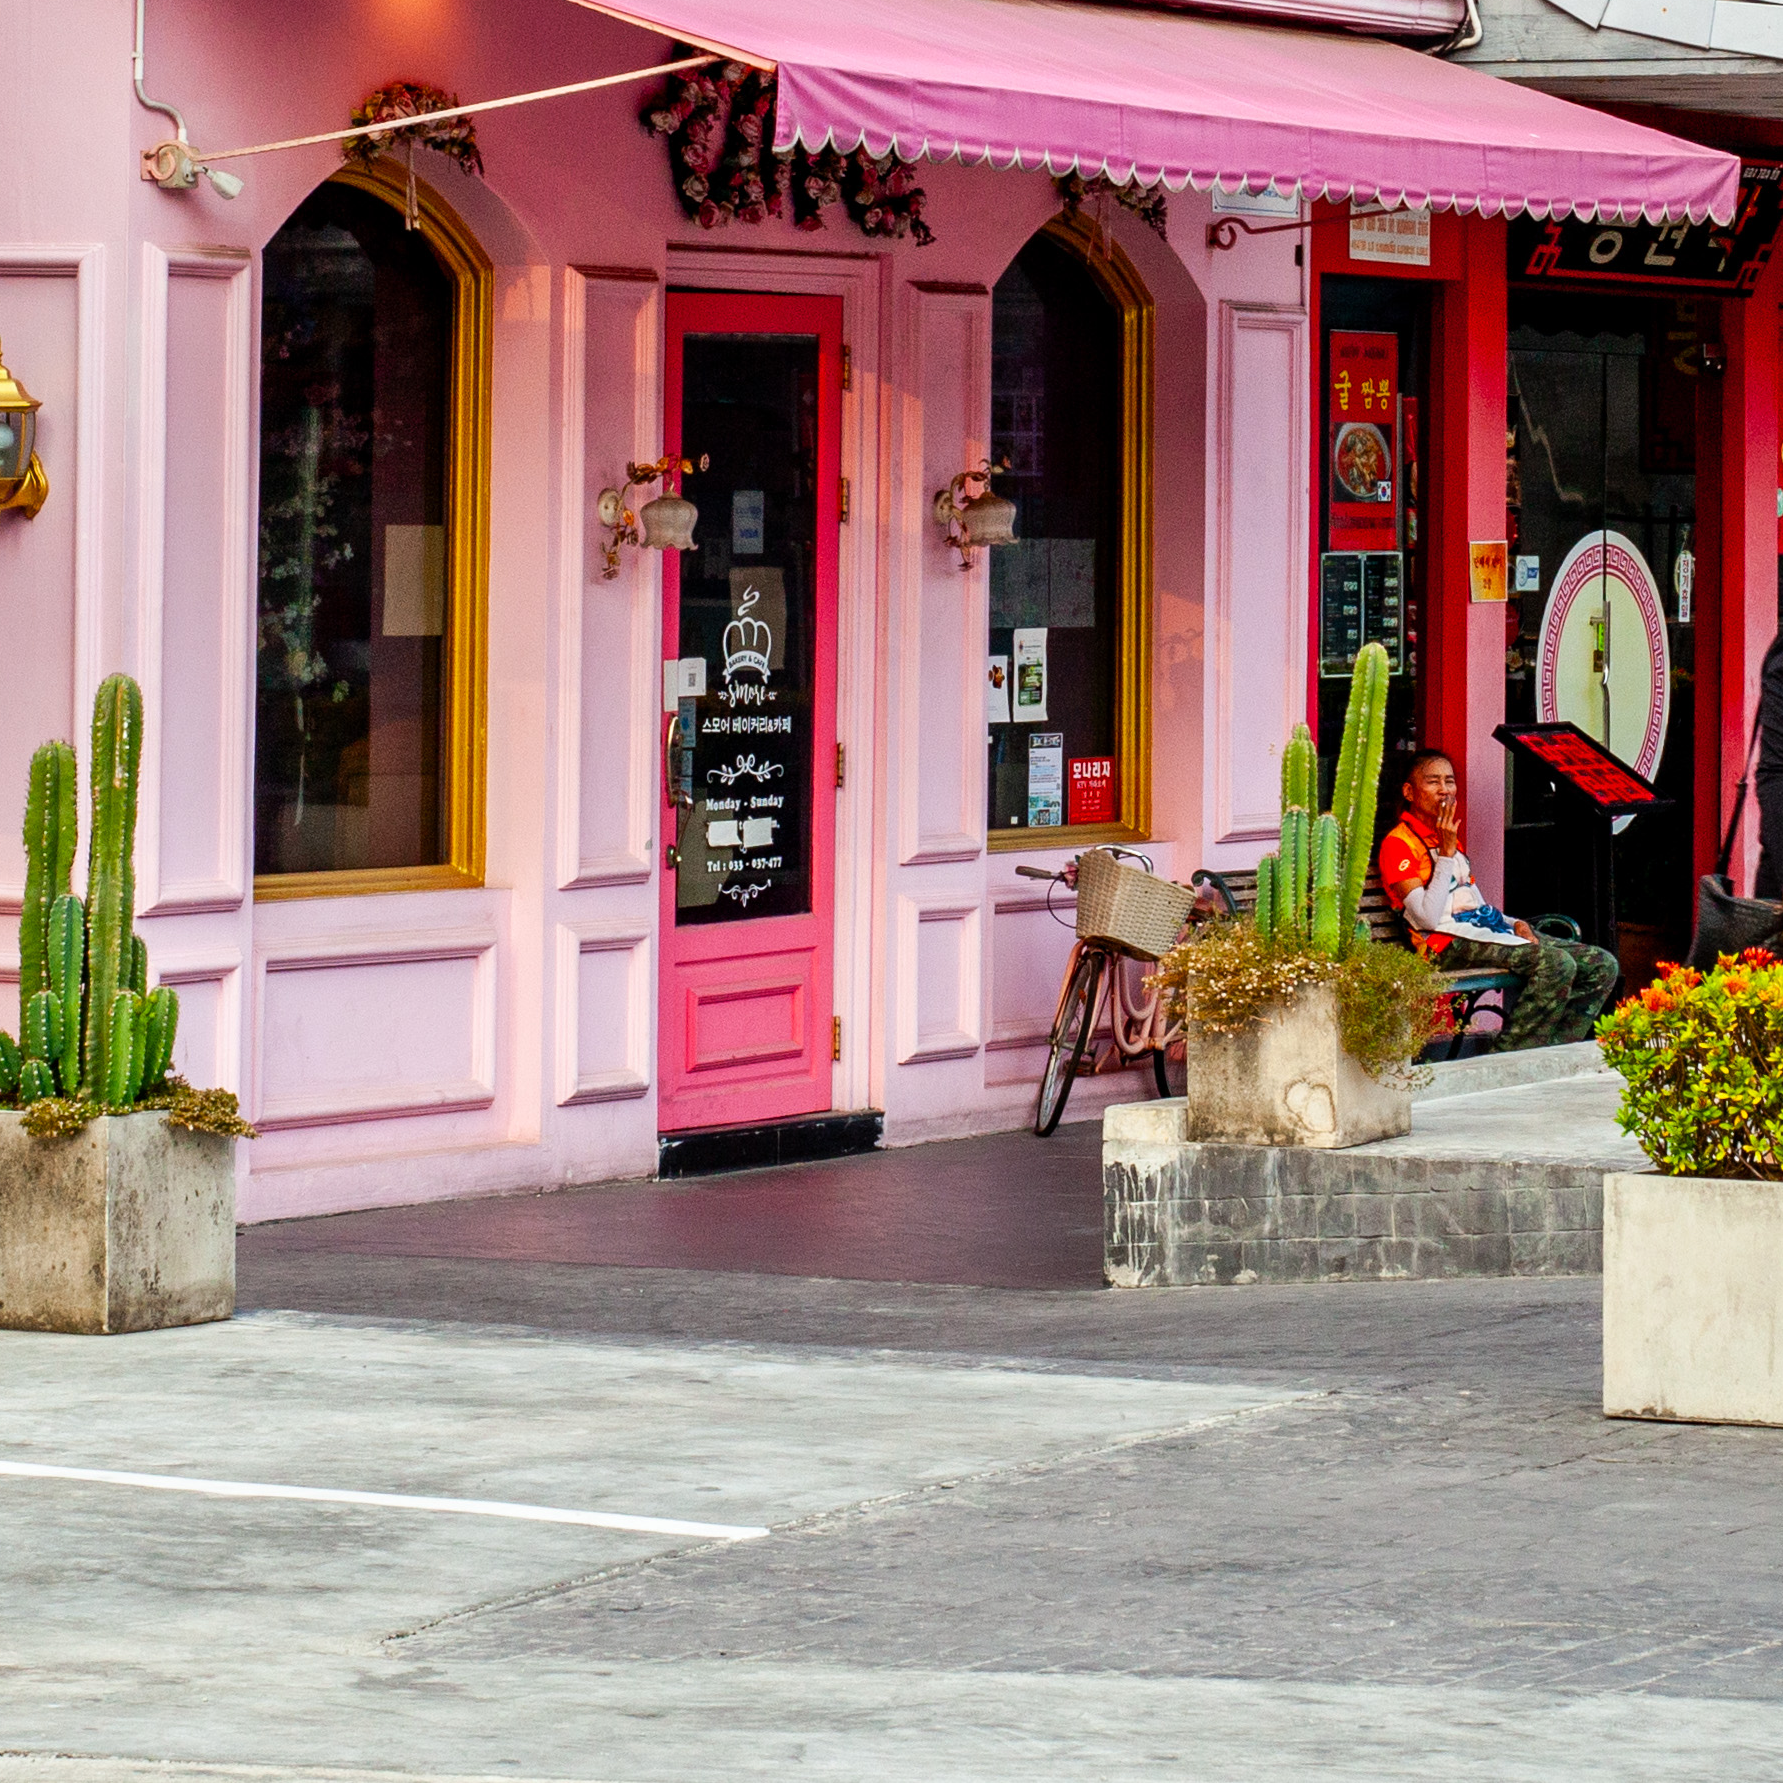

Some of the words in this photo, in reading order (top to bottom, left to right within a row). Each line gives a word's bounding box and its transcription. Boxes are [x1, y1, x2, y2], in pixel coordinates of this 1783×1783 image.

[1334, 369, 1352, 411] 굴
[1361, 377, 1391, 411] 짬뽕
[728, 655, 748, 669] BAKERY
[702, 716, 731, 734] 스모어
[732, 716, 792, 734] 베이커리&카페
[1072, 761, 1111, 779] 모나리자
[705, 797, 742, 812] Monday
[750, 794, 784, 809] Sunday
[728, 859, 744, 872] 033
[751, 856, 783, 869] 037-477
